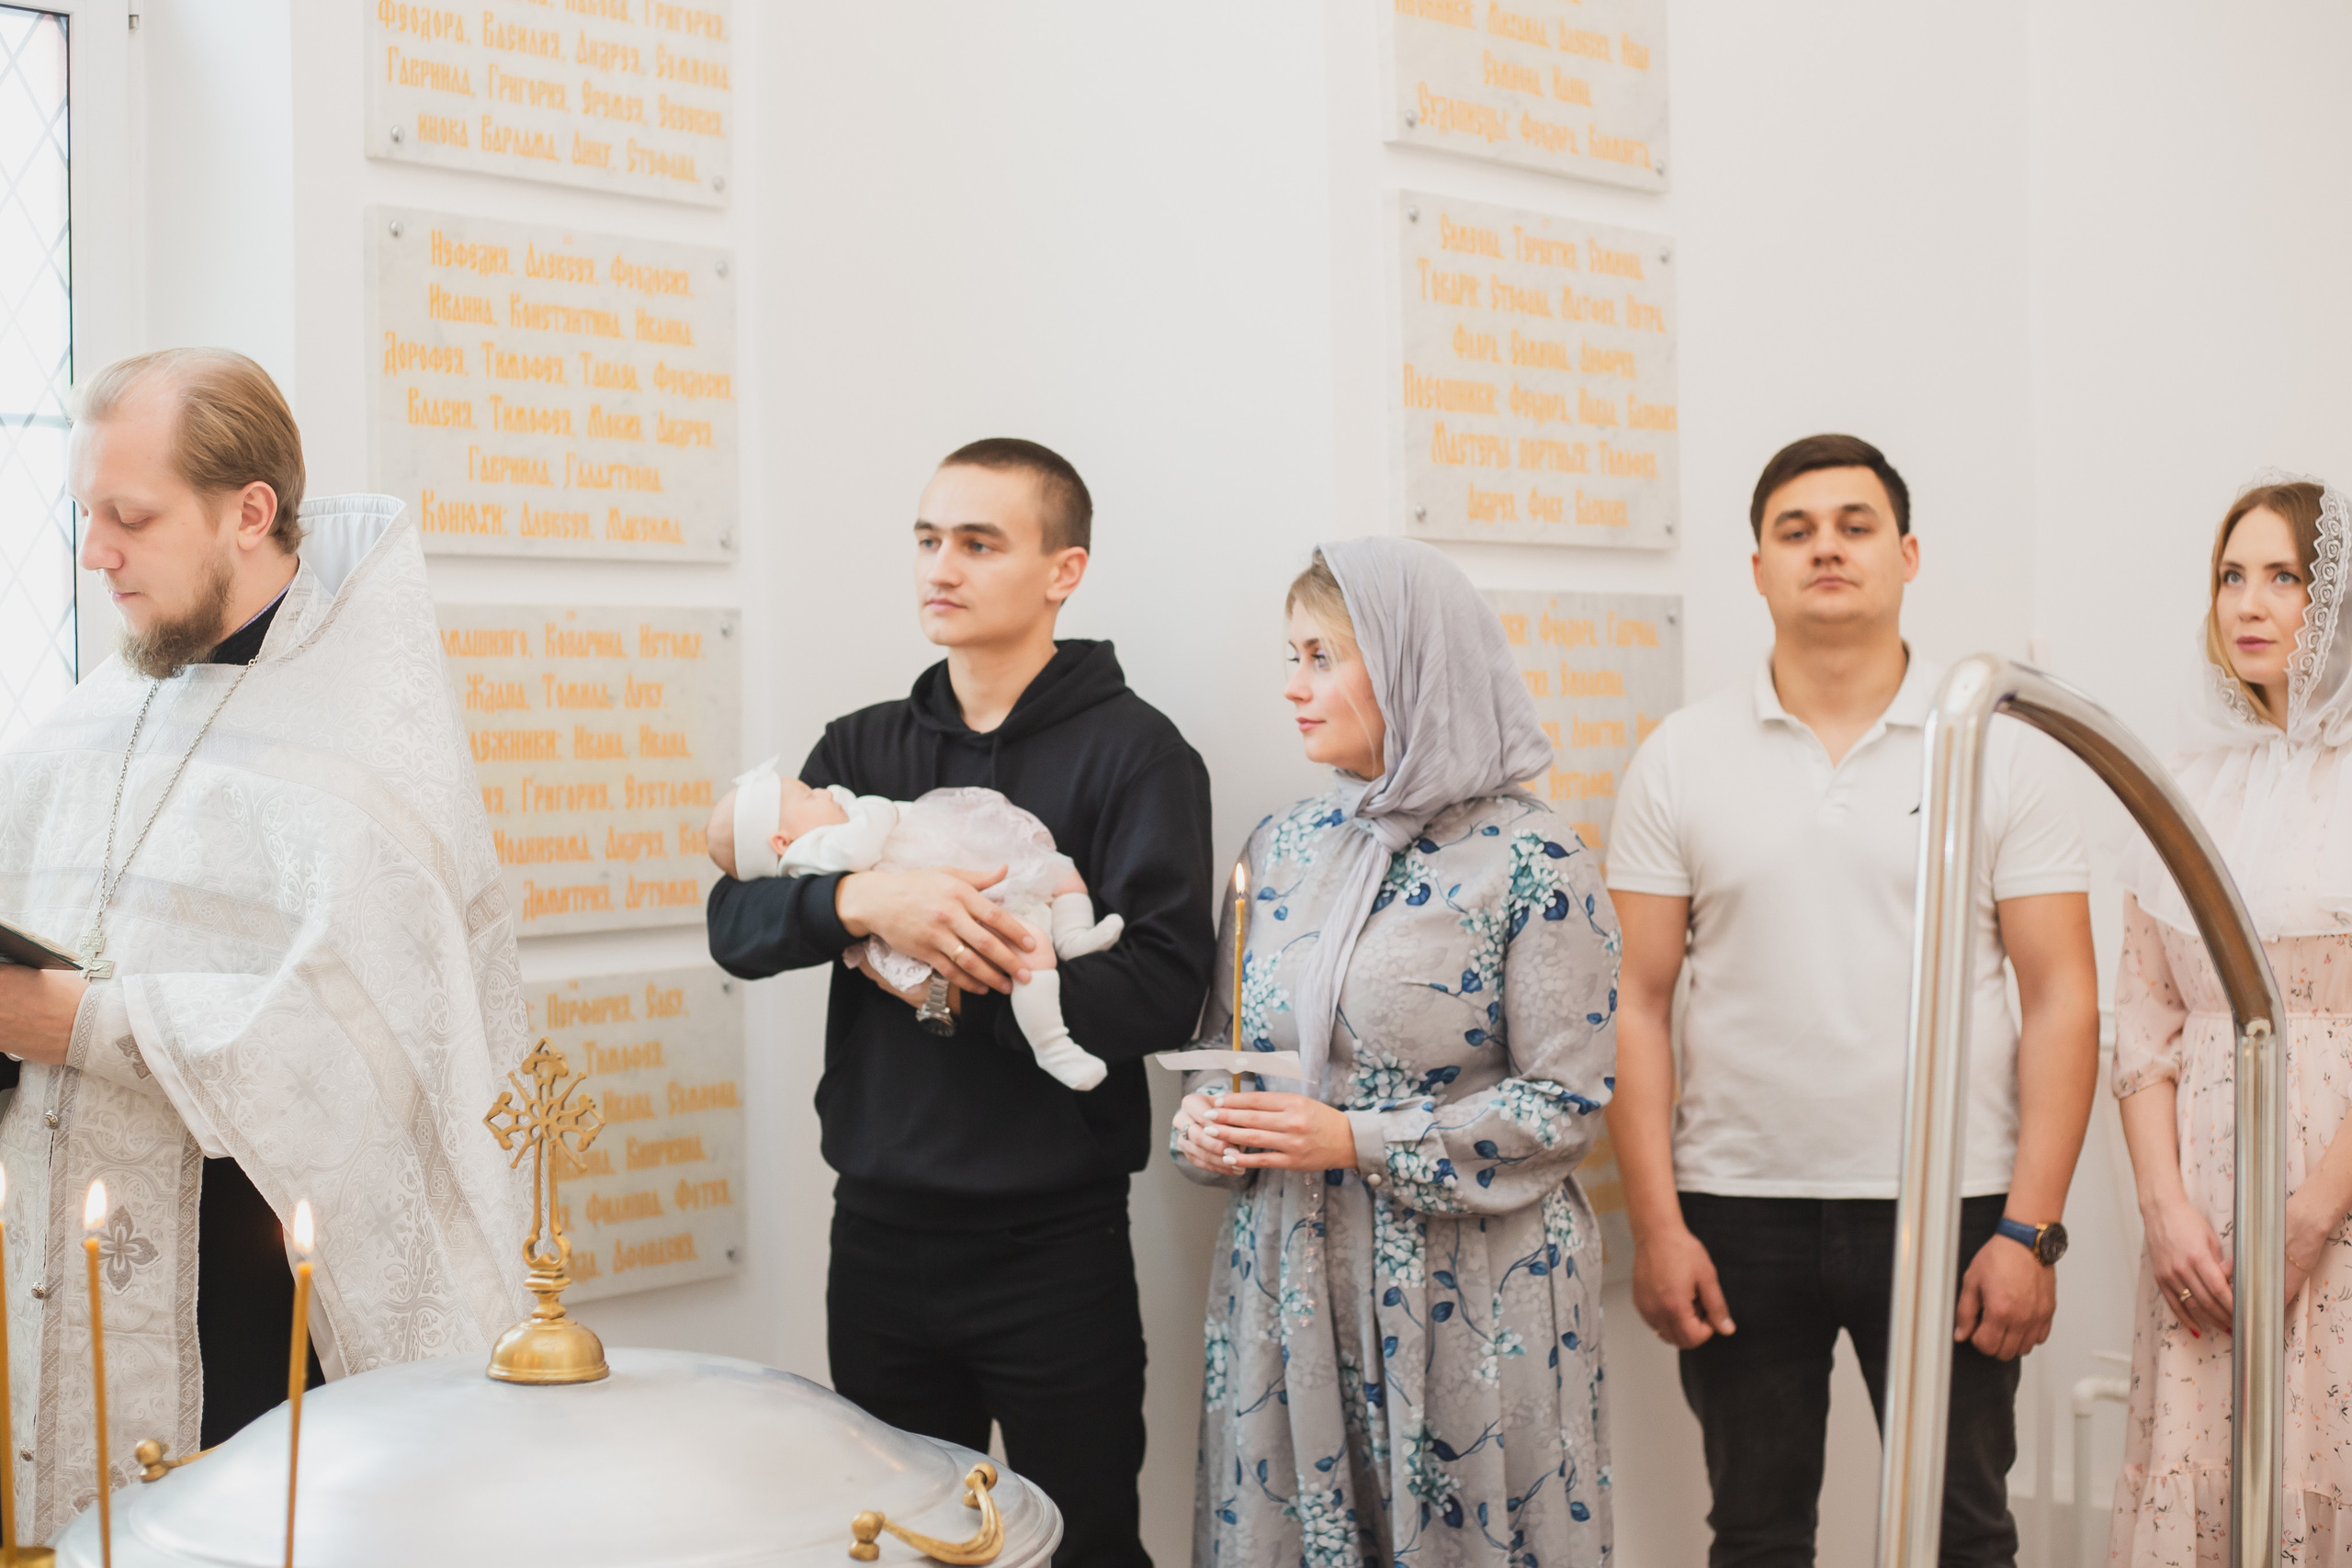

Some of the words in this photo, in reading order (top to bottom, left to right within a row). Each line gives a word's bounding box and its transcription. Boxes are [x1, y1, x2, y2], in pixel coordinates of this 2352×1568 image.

[418, 112, 469, 147] инока
[384, 330, 469, 378] Дорофея,
[407, 387, 479, 432] Власия,
[421, 489, 509, 536] Конюхи:
